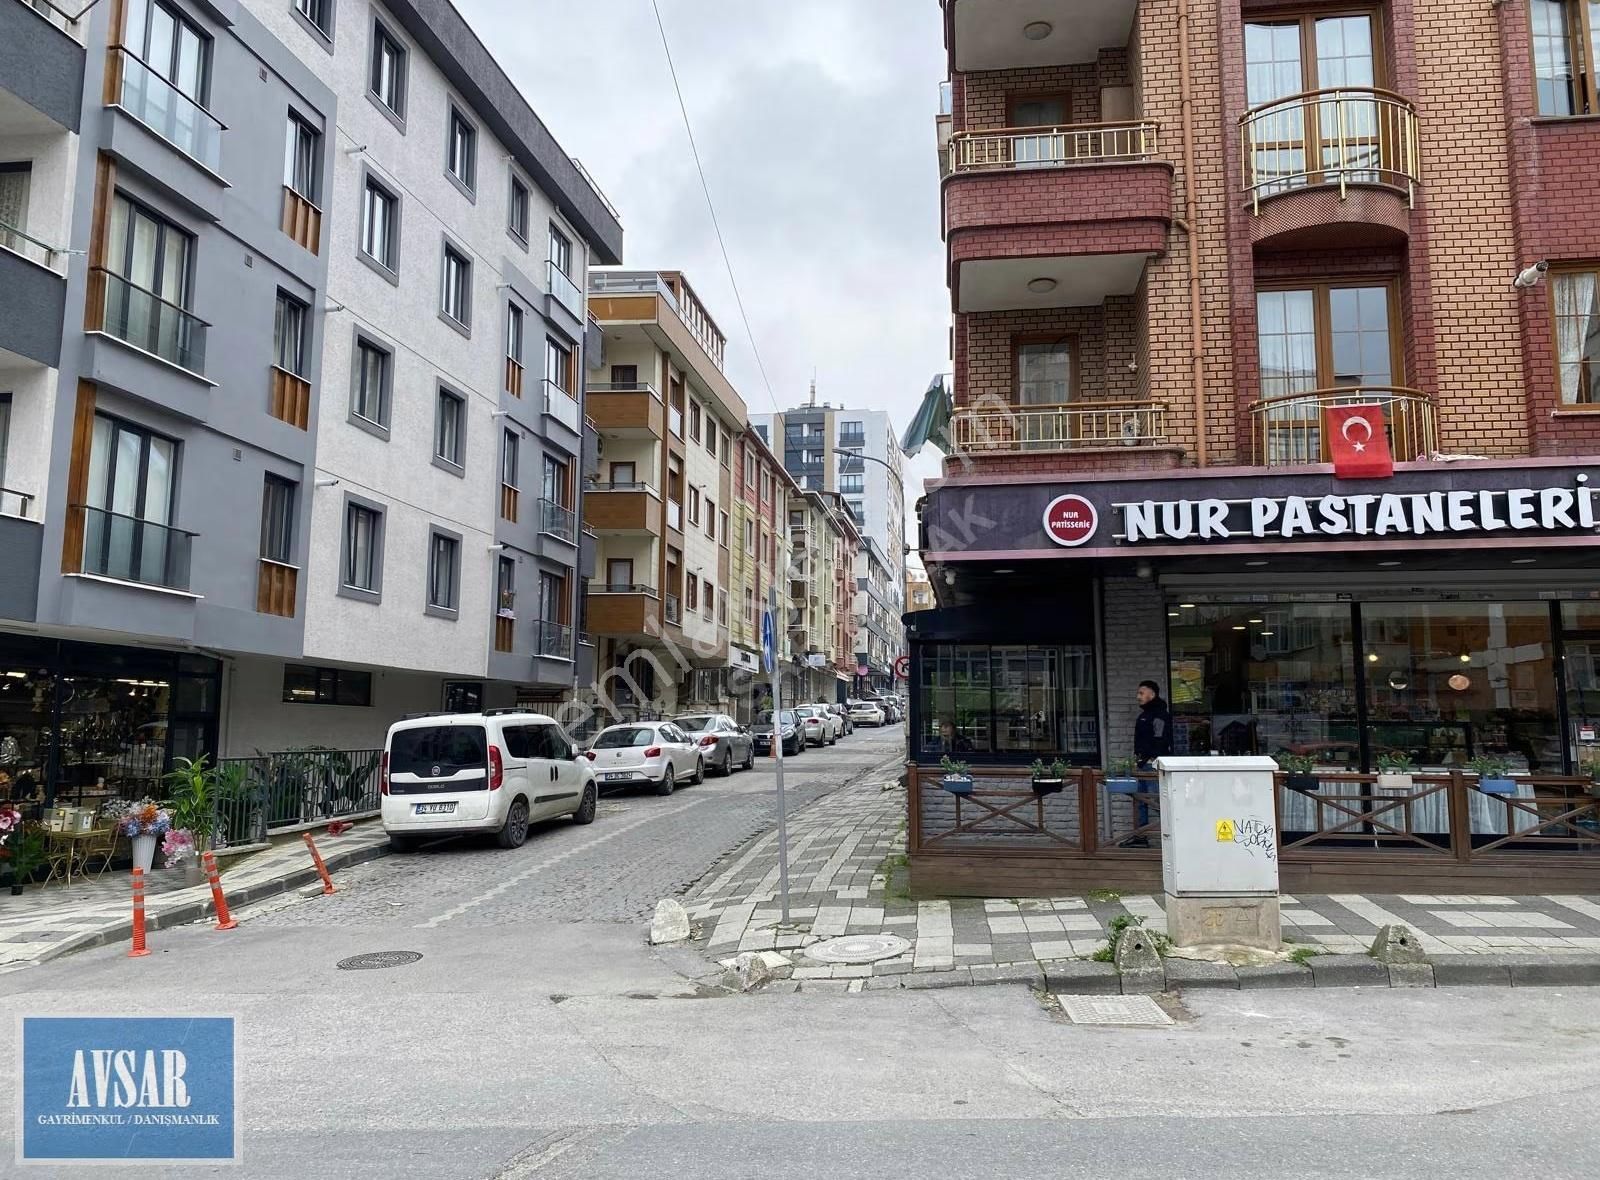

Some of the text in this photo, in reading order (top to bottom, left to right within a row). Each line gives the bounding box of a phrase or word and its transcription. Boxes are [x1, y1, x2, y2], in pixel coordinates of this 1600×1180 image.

[1063, 511, 1079, 519] NUR
[1126, 473, 1594, 542] NUR PASTANELERİ
